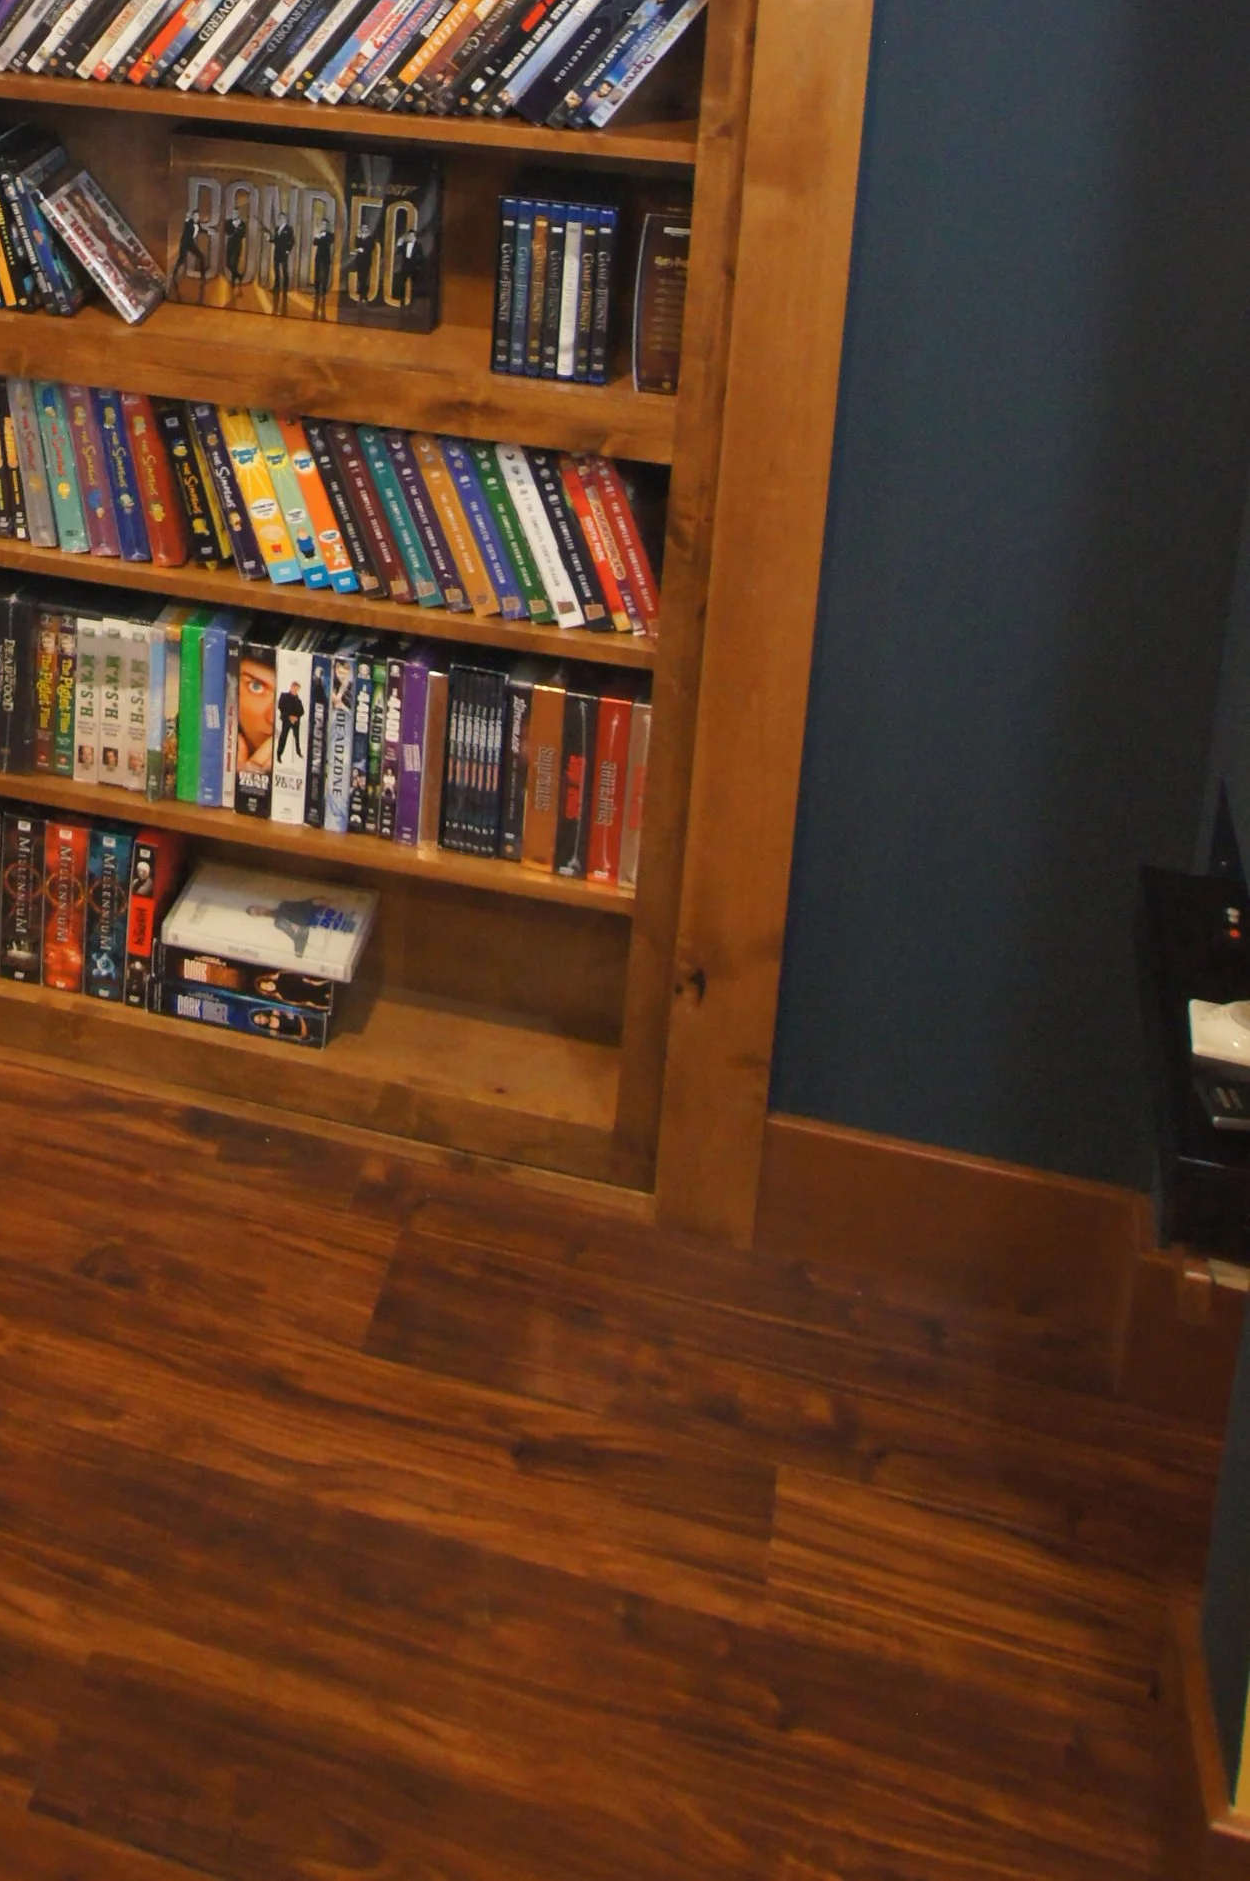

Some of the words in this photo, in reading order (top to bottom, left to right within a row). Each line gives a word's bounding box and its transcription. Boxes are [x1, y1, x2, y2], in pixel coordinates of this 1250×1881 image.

[553, 27, 602, 84] COLLECTION
[186, 176, 337, 293] BOND
[349, 194, 418, 307] 50
[2, 638, 15, 712] DEADWOOD
[37, 671, 53, 706] Piglet
[57, 676, 73, 711] Piglet
[355, 690, 369, 733] 4400
[370, 705, 383, 744] 4400
[385, 696, 400, 743] 4400
